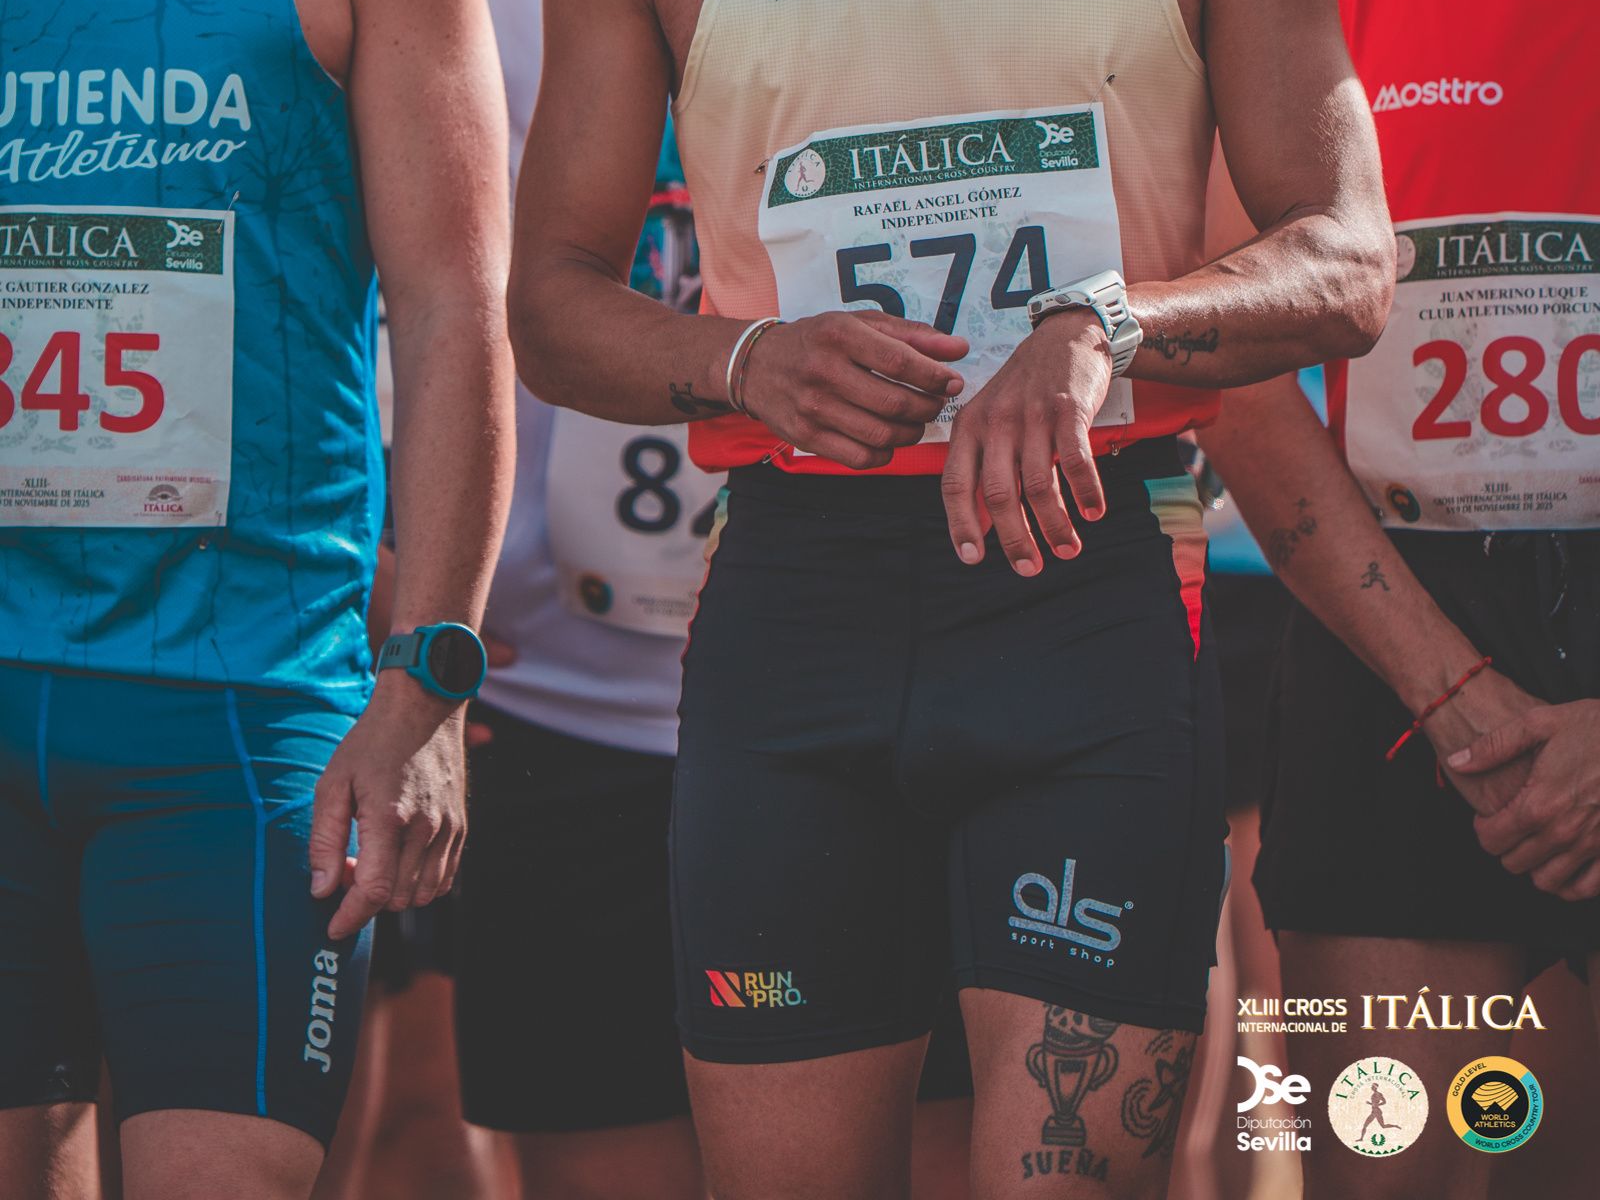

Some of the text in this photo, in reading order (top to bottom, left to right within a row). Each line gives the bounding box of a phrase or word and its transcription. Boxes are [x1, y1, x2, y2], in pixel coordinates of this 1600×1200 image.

[0, 130, 246, 183] Atletismo
[849, 131, 1014, 180] ITÁLICA
[1039, 148, 1078, 158] Diputación
[1041, 155, 1079, 169] Sevilla
[854, 164, 1016, 190] INTERNATIONAL CROSS COUNTRY
[853, 187, 1022, 217] RAFAEL ANGEL GÓMEZ
[881, 205, 998, 230] INDEPENDIENTE
[0, 216, 139, 258] TÁLICA
[1437, 226, 1594, 268] ITÁLICA
[166, 257, 203, 270] Sevilla
[6, 282, 149, 294] GAUTIER GONZALEZ
[835, 225, 1052, 336] 574
[2, 298, 113, 310] INDEPENDIENTE
[1440, 286, 1588, 303] JUAN MERINO LUQUE
[1419, 308, 1454, 321] CLUB
[1458, 303, 1538, 319] ATLETISMO
[0, 332, 164, 433] 45
[1412, 333, 1600, 442] 280
[1011, 932, 1115, 968] sport shop
[744, 971, 792, 990] RUN
